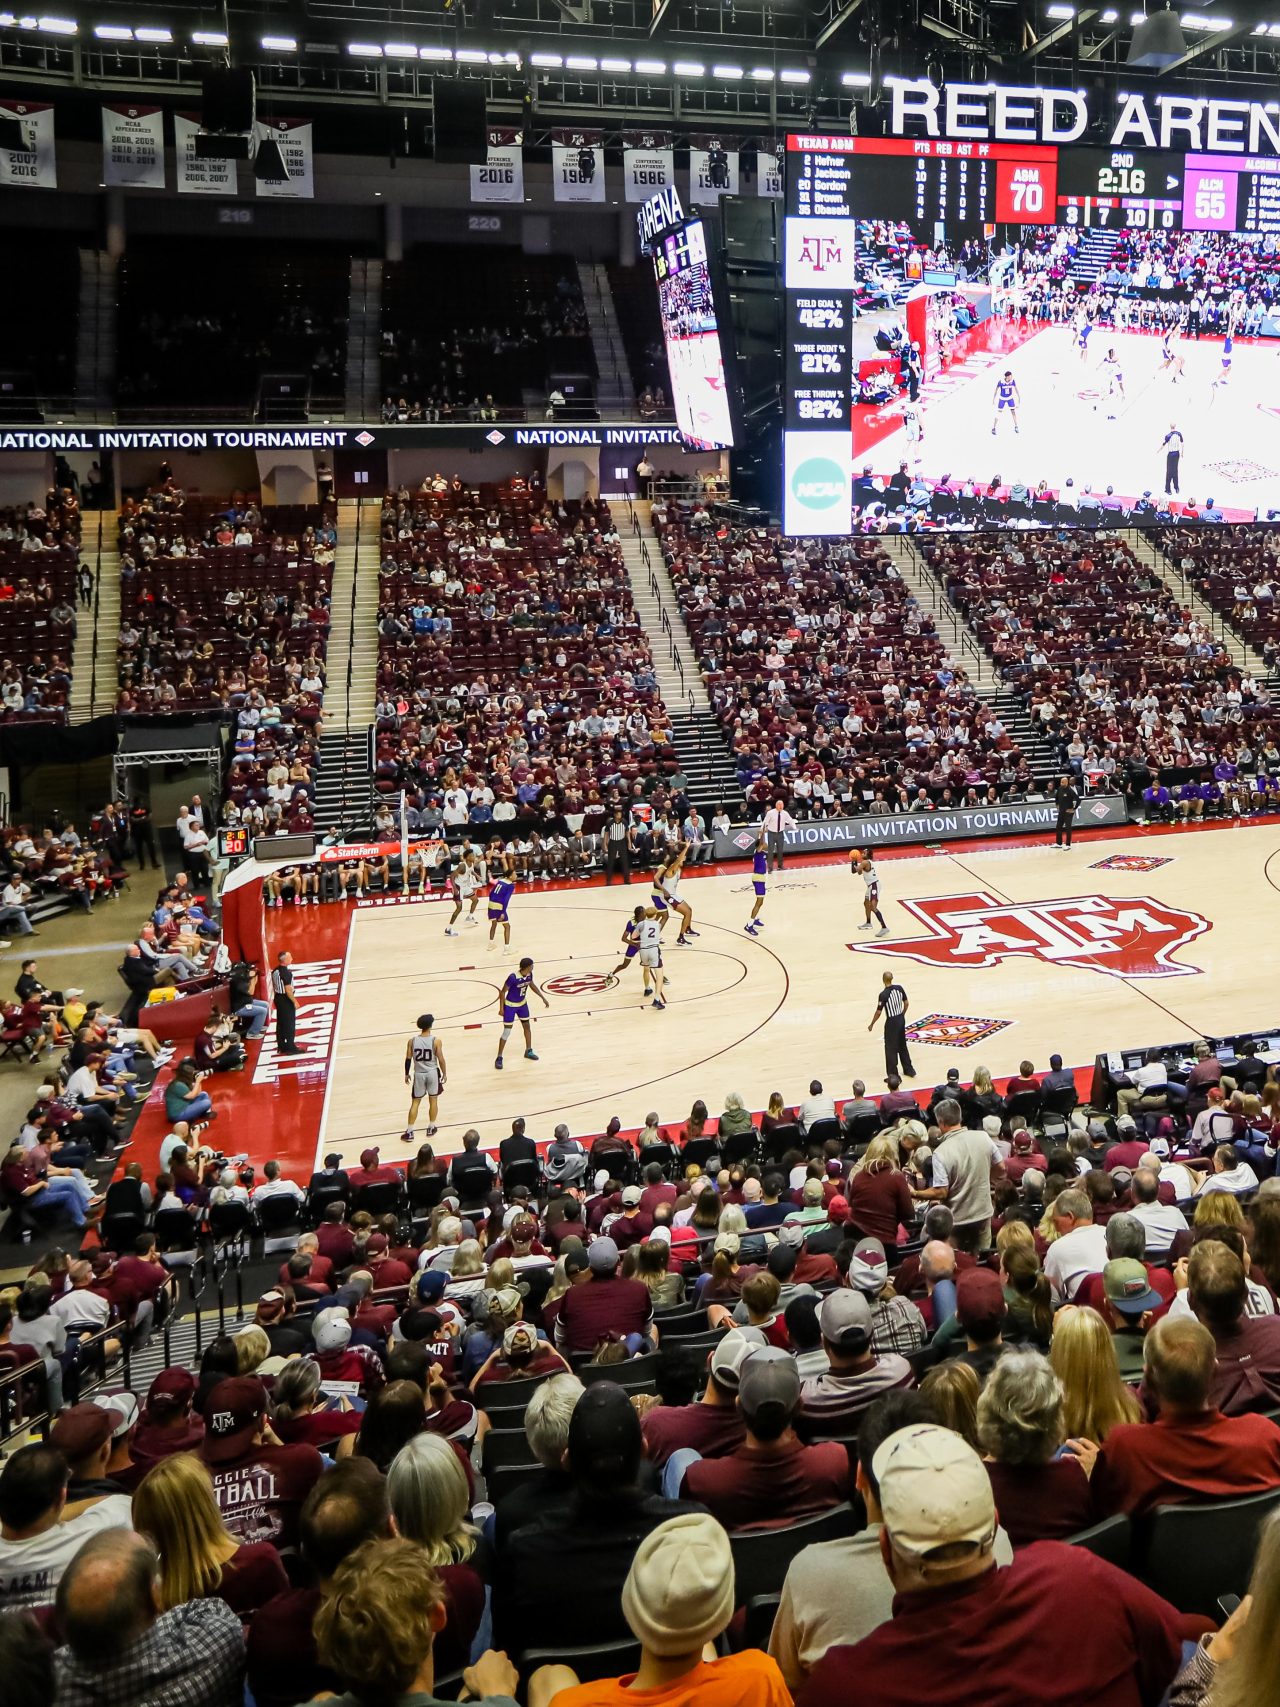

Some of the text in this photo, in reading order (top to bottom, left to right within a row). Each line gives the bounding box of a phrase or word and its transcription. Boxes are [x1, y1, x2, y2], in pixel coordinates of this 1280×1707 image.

[891, 78, 1088, 142] REED
[914, 142, 931, 154] PTS
[957, 144, 972, 156] AST
[9, 153, 37, 164] 2007
[1111, 153, 1134, 169] 2ND
[11, 165, 37, 177] 2016
[479, 168, 514, 184] 2016
[633, 170, 666, 185] 1986
[1097, 167, 1146, 194] 2:16
[1010, 182, 1044, 212] 70
[643, 184, 685, 240] ARENA
[1194, 191, 1226, 220] 55
[469, 216, 500, 230] 220
[1098, 207, 1110, 226] 7
[1126, 208, 1147, 227] 10
[1162, 210, 1174, 228] 0
[797, 299, 835, 308] FIELD GOAL
[799, 309, 843, 328] 42%
[794, 344, 839, 353] THREE POINT
[801, 354, 841, 373] 21%
[794, 390, 836, 399] FREE THROW
[799, 399, 842, 419] 92%
[100, 433, 207, 448] INVITATION
[213, 431, 347, 447] TOURNAMENT
[516, 430, 602, 444] NATIONAL
[861, 806, 1080, 838] INVITATION TOURNAMET
[226, 830, 246, 841] 2:16
[225, 841, 242, 853] 20
[647, 927, 656, 939] 2
[413, 1048, 433, 1062] 20
[214, 1468, 250, 1486] GGIE
[213, 1474, 281, 1507] TBALL
